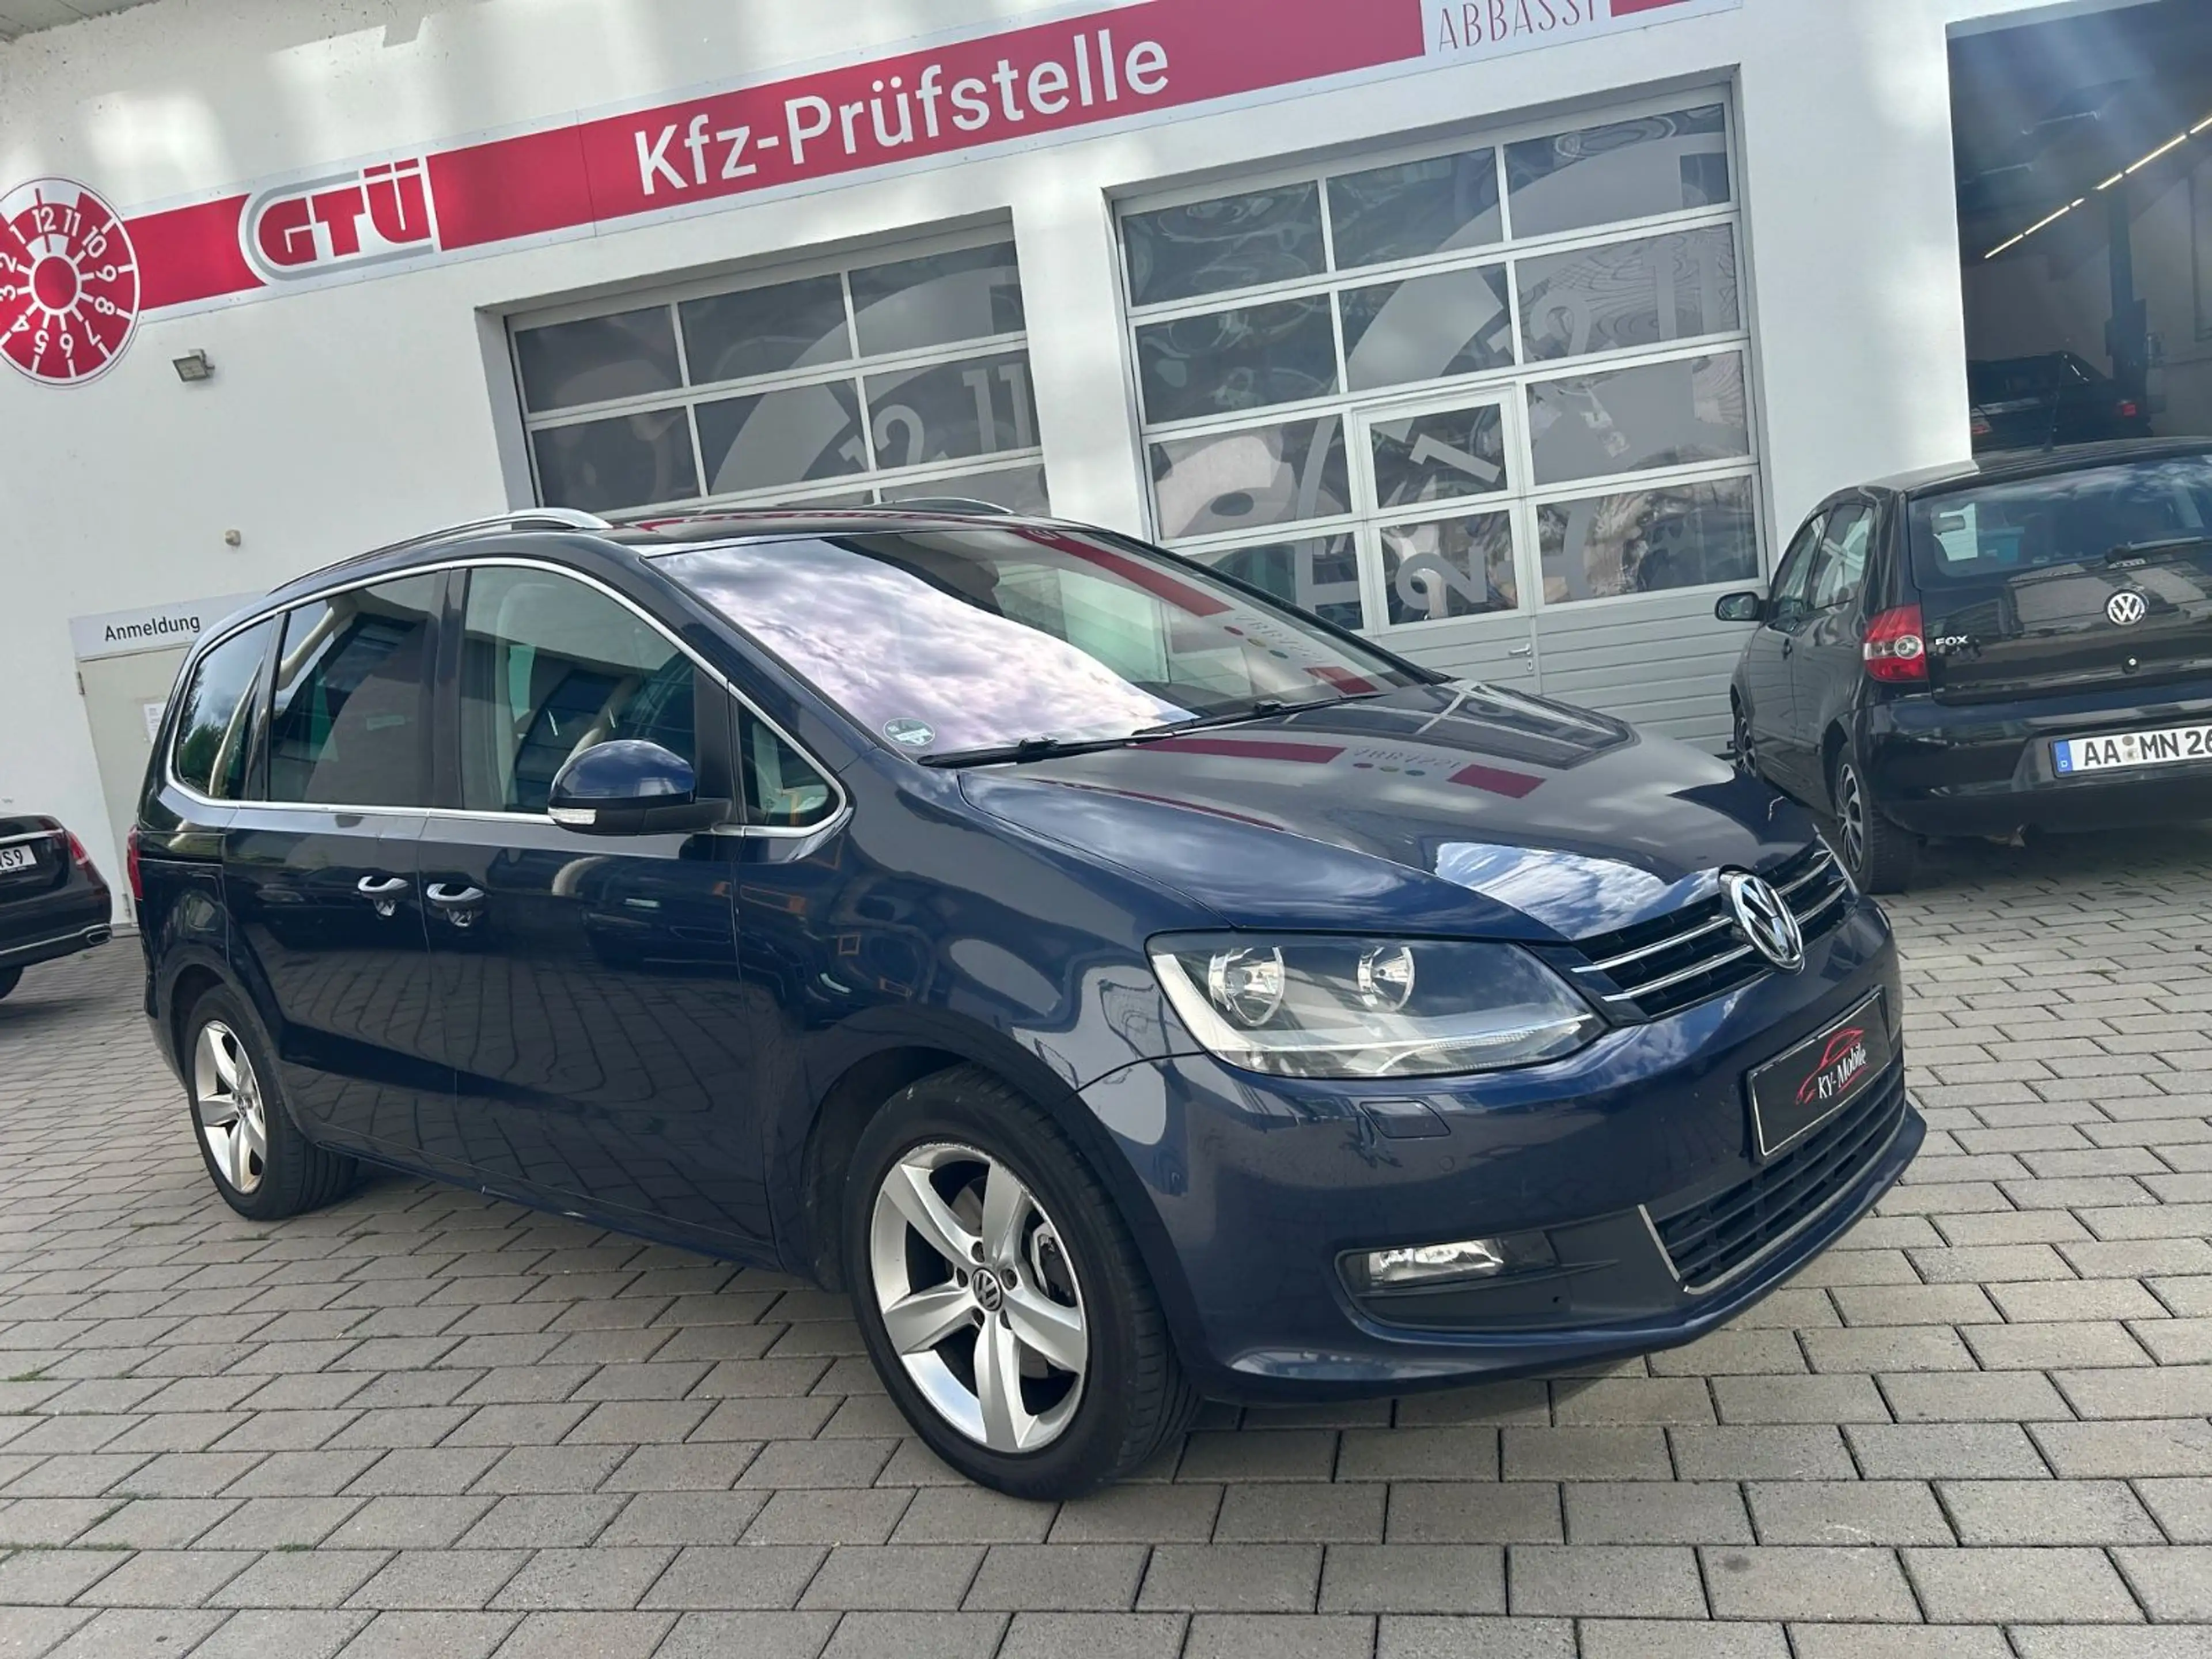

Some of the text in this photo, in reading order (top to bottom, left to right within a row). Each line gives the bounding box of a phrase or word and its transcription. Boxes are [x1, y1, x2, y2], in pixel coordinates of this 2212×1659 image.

[634, 29, 1169, 195] Kfz-Prüfstelle
[32, 206, 56, 233] 12
[64, 209, 81, 237] 11
[259, 158, 431, 266] GTÜ
[82, 226, 107, 258] 10
[94, 264, 117, 282] 9
[94, 296, 115, 315] 8
[10, 315, 30, 332] 4
[85, 319, 101, 346] 7
[33, 329, 50, 355] 5
[59, 334, 74, 358] 6
[105, 616, 200, 642] Anmeldung
[1936, 635, 1969, 645] FOX
[2084, 740, 2121, 766] AA
[2139, 733, 2180, 759] MN
